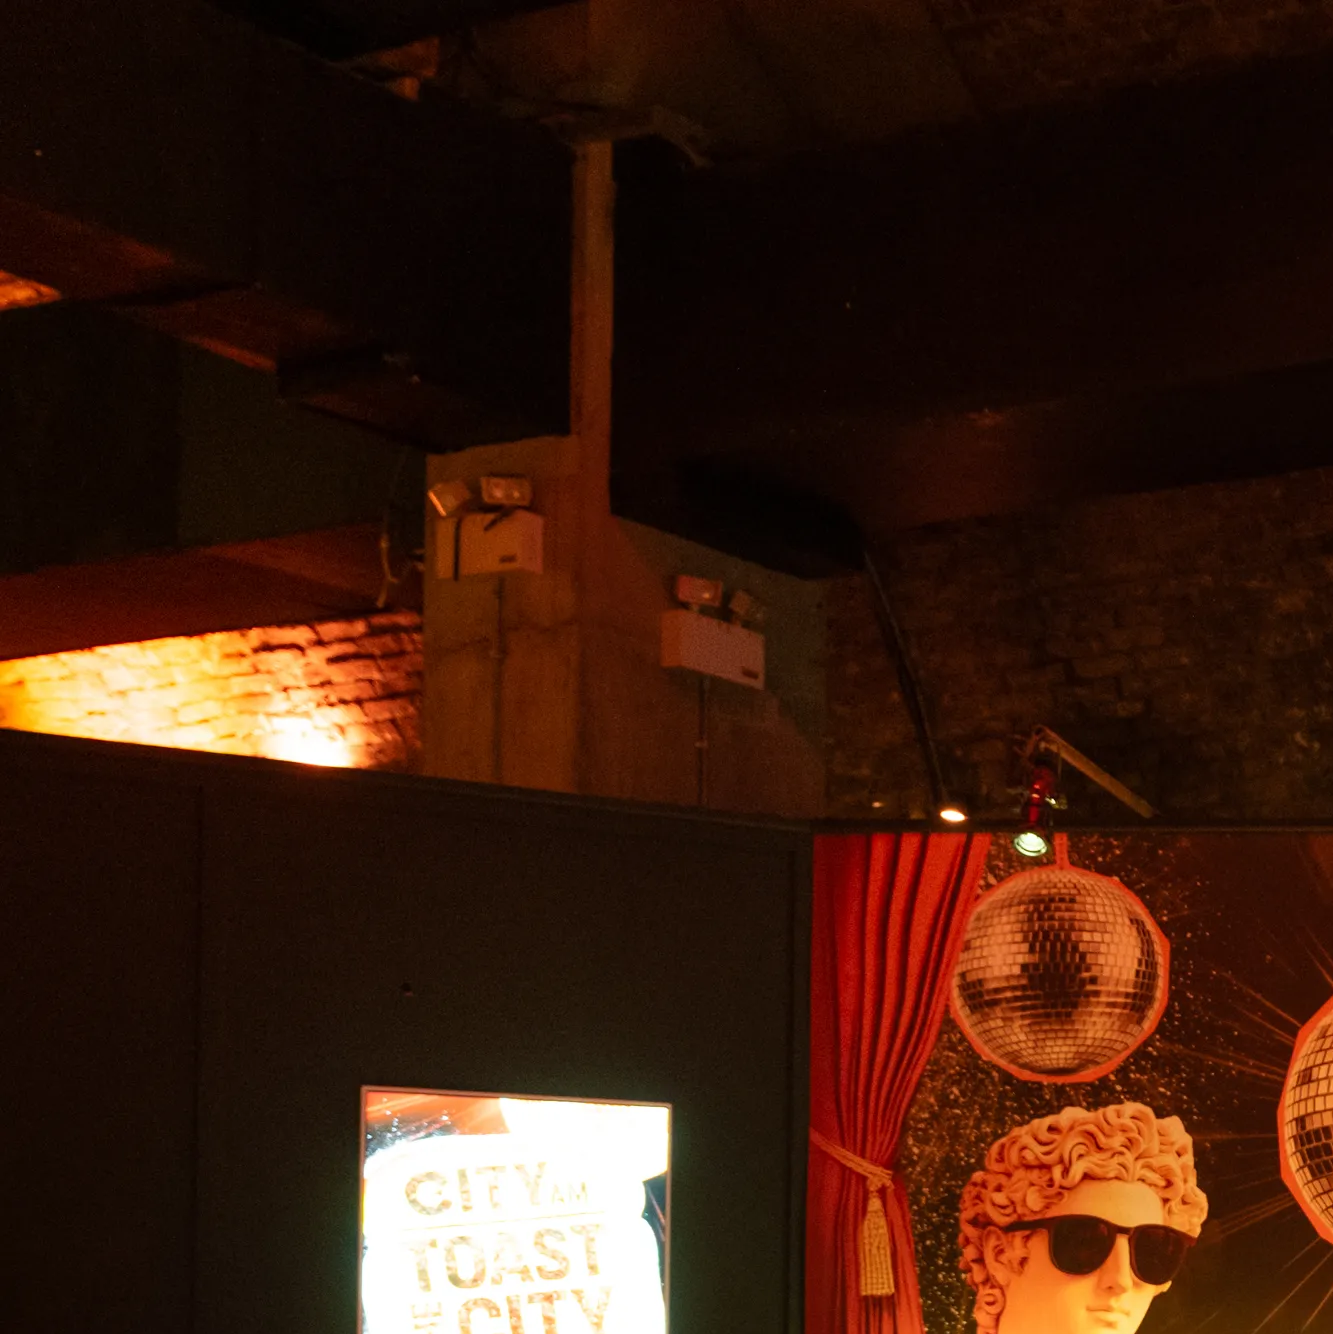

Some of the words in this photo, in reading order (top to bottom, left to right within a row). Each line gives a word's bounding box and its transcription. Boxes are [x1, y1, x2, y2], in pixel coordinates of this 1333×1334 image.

[404, 1162, 547, 1216] CITY
[550, 1181, 589, 1206] AM
[401, 1223, 604, 1293] TOAST
